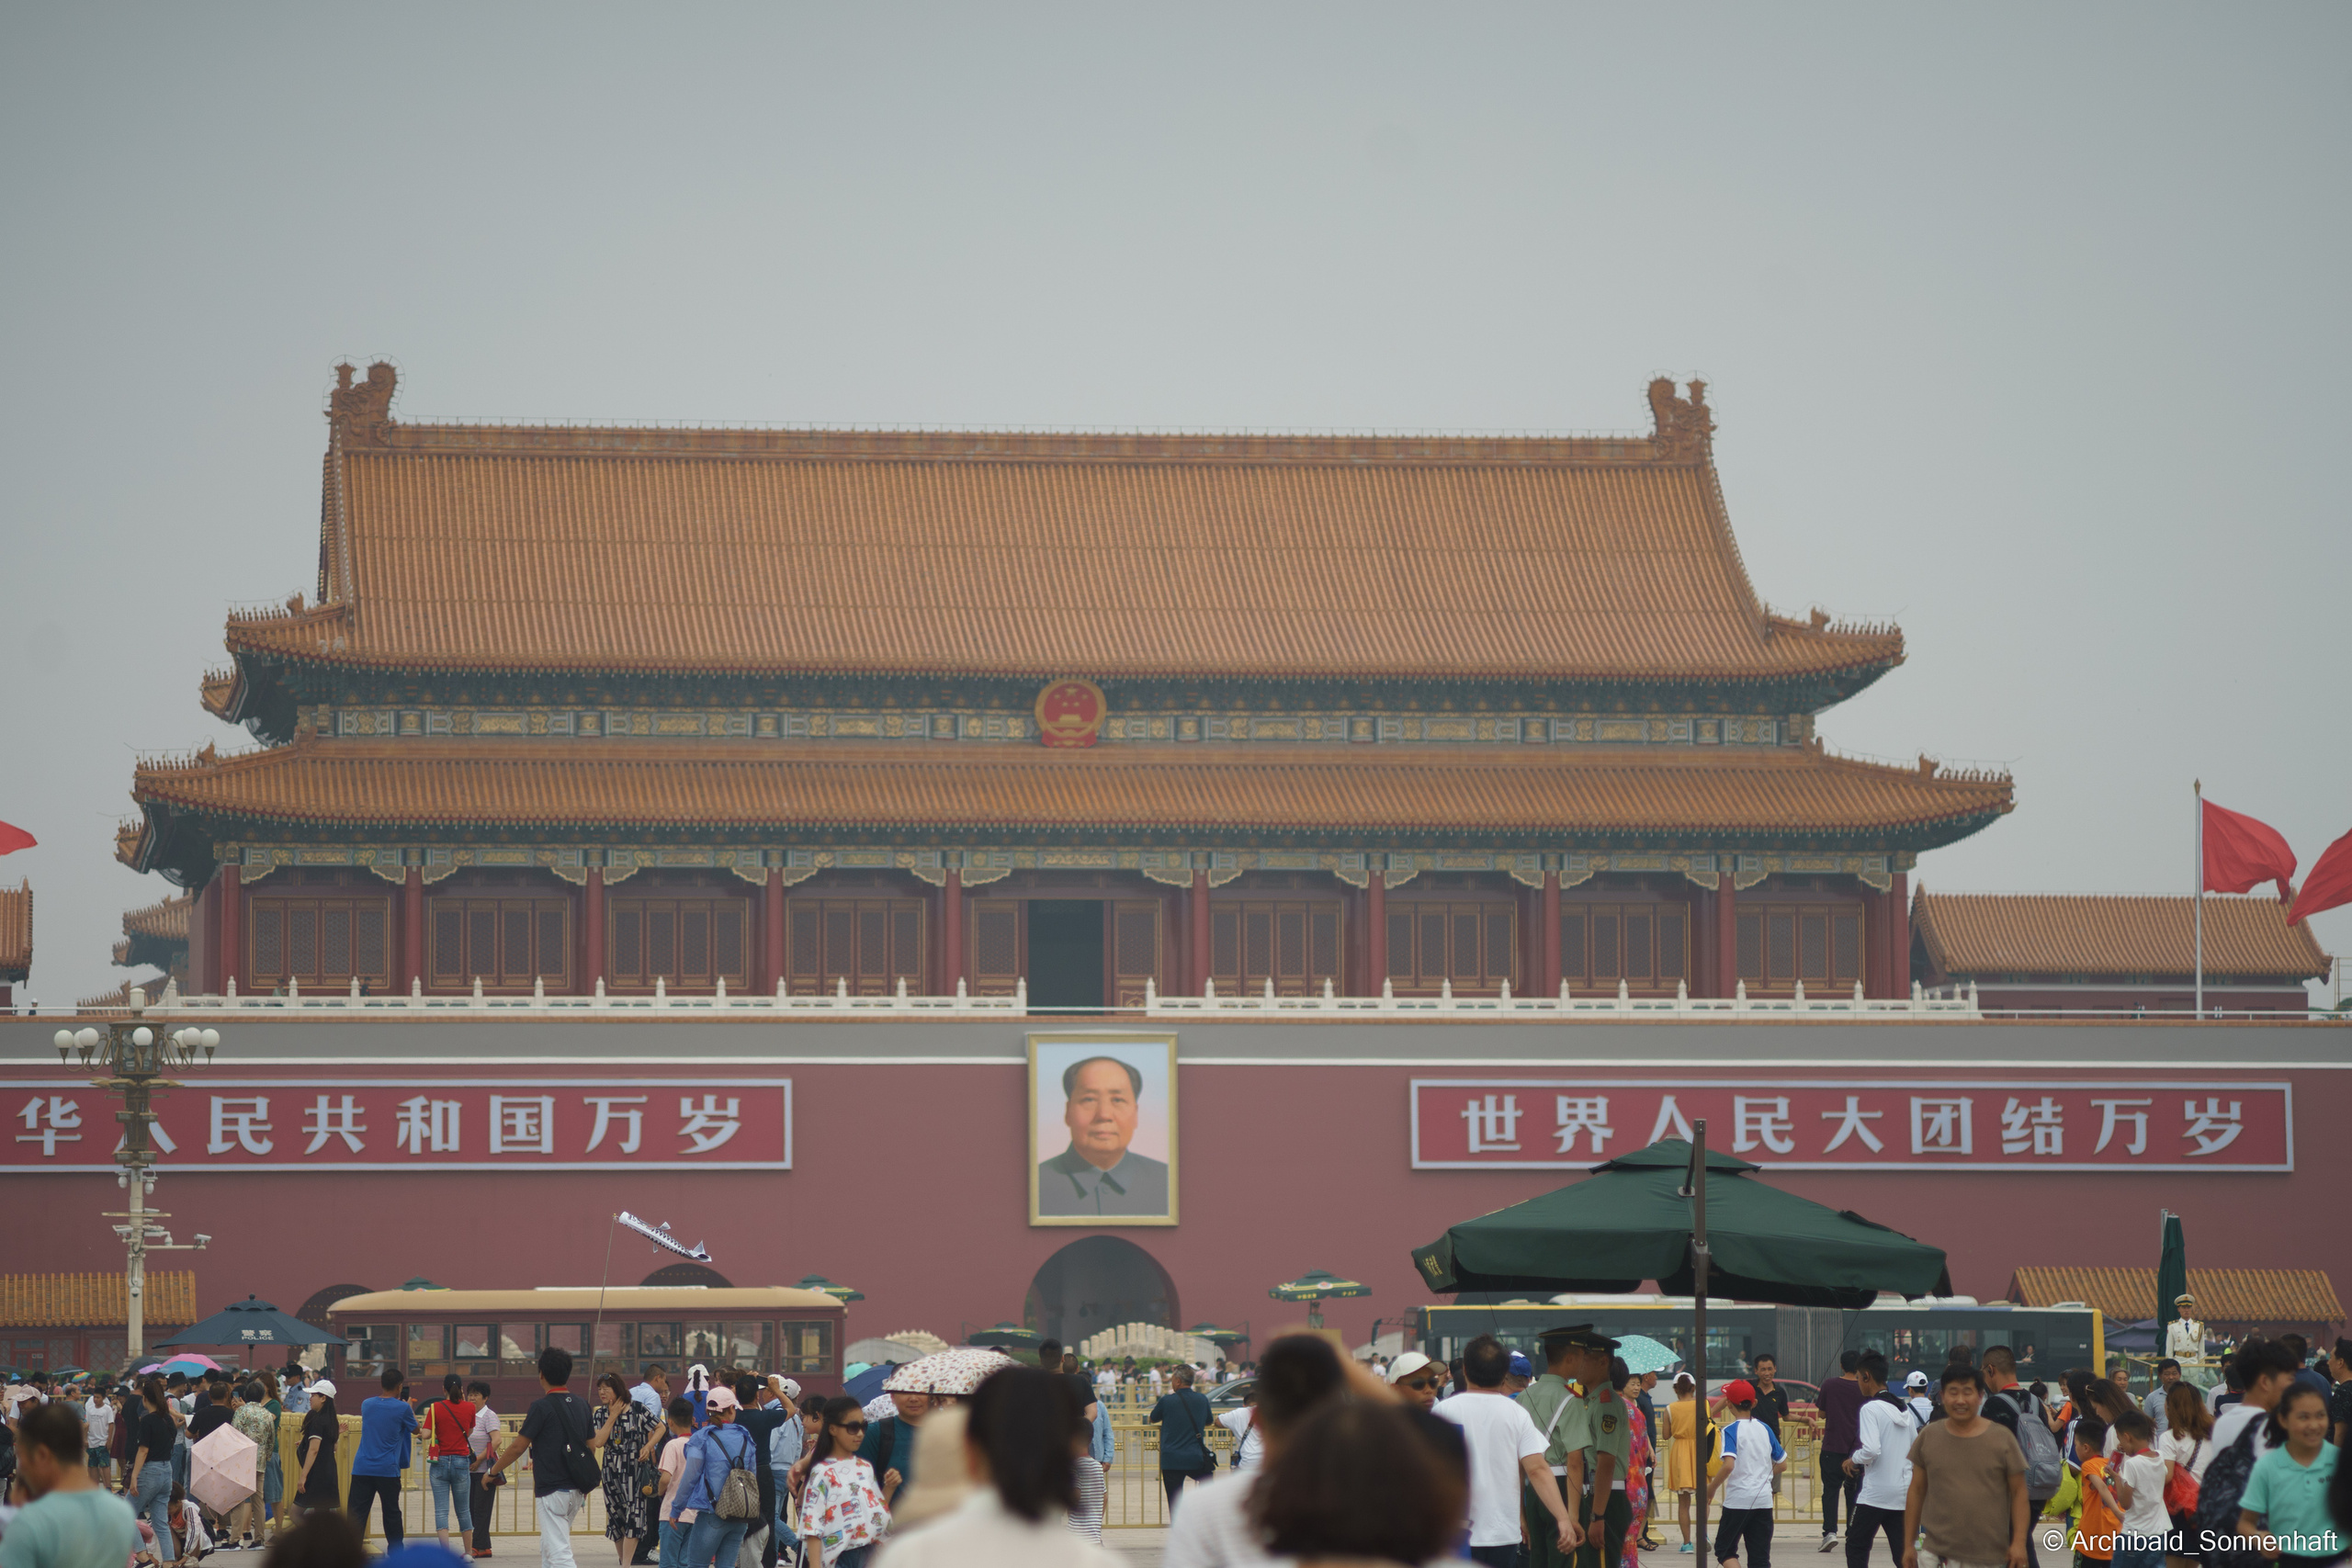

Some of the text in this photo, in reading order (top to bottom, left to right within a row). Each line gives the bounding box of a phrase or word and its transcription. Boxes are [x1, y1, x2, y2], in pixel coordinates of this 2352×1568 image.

[1461, 1095, 2245, 1156] 世界人民大团结万岁
